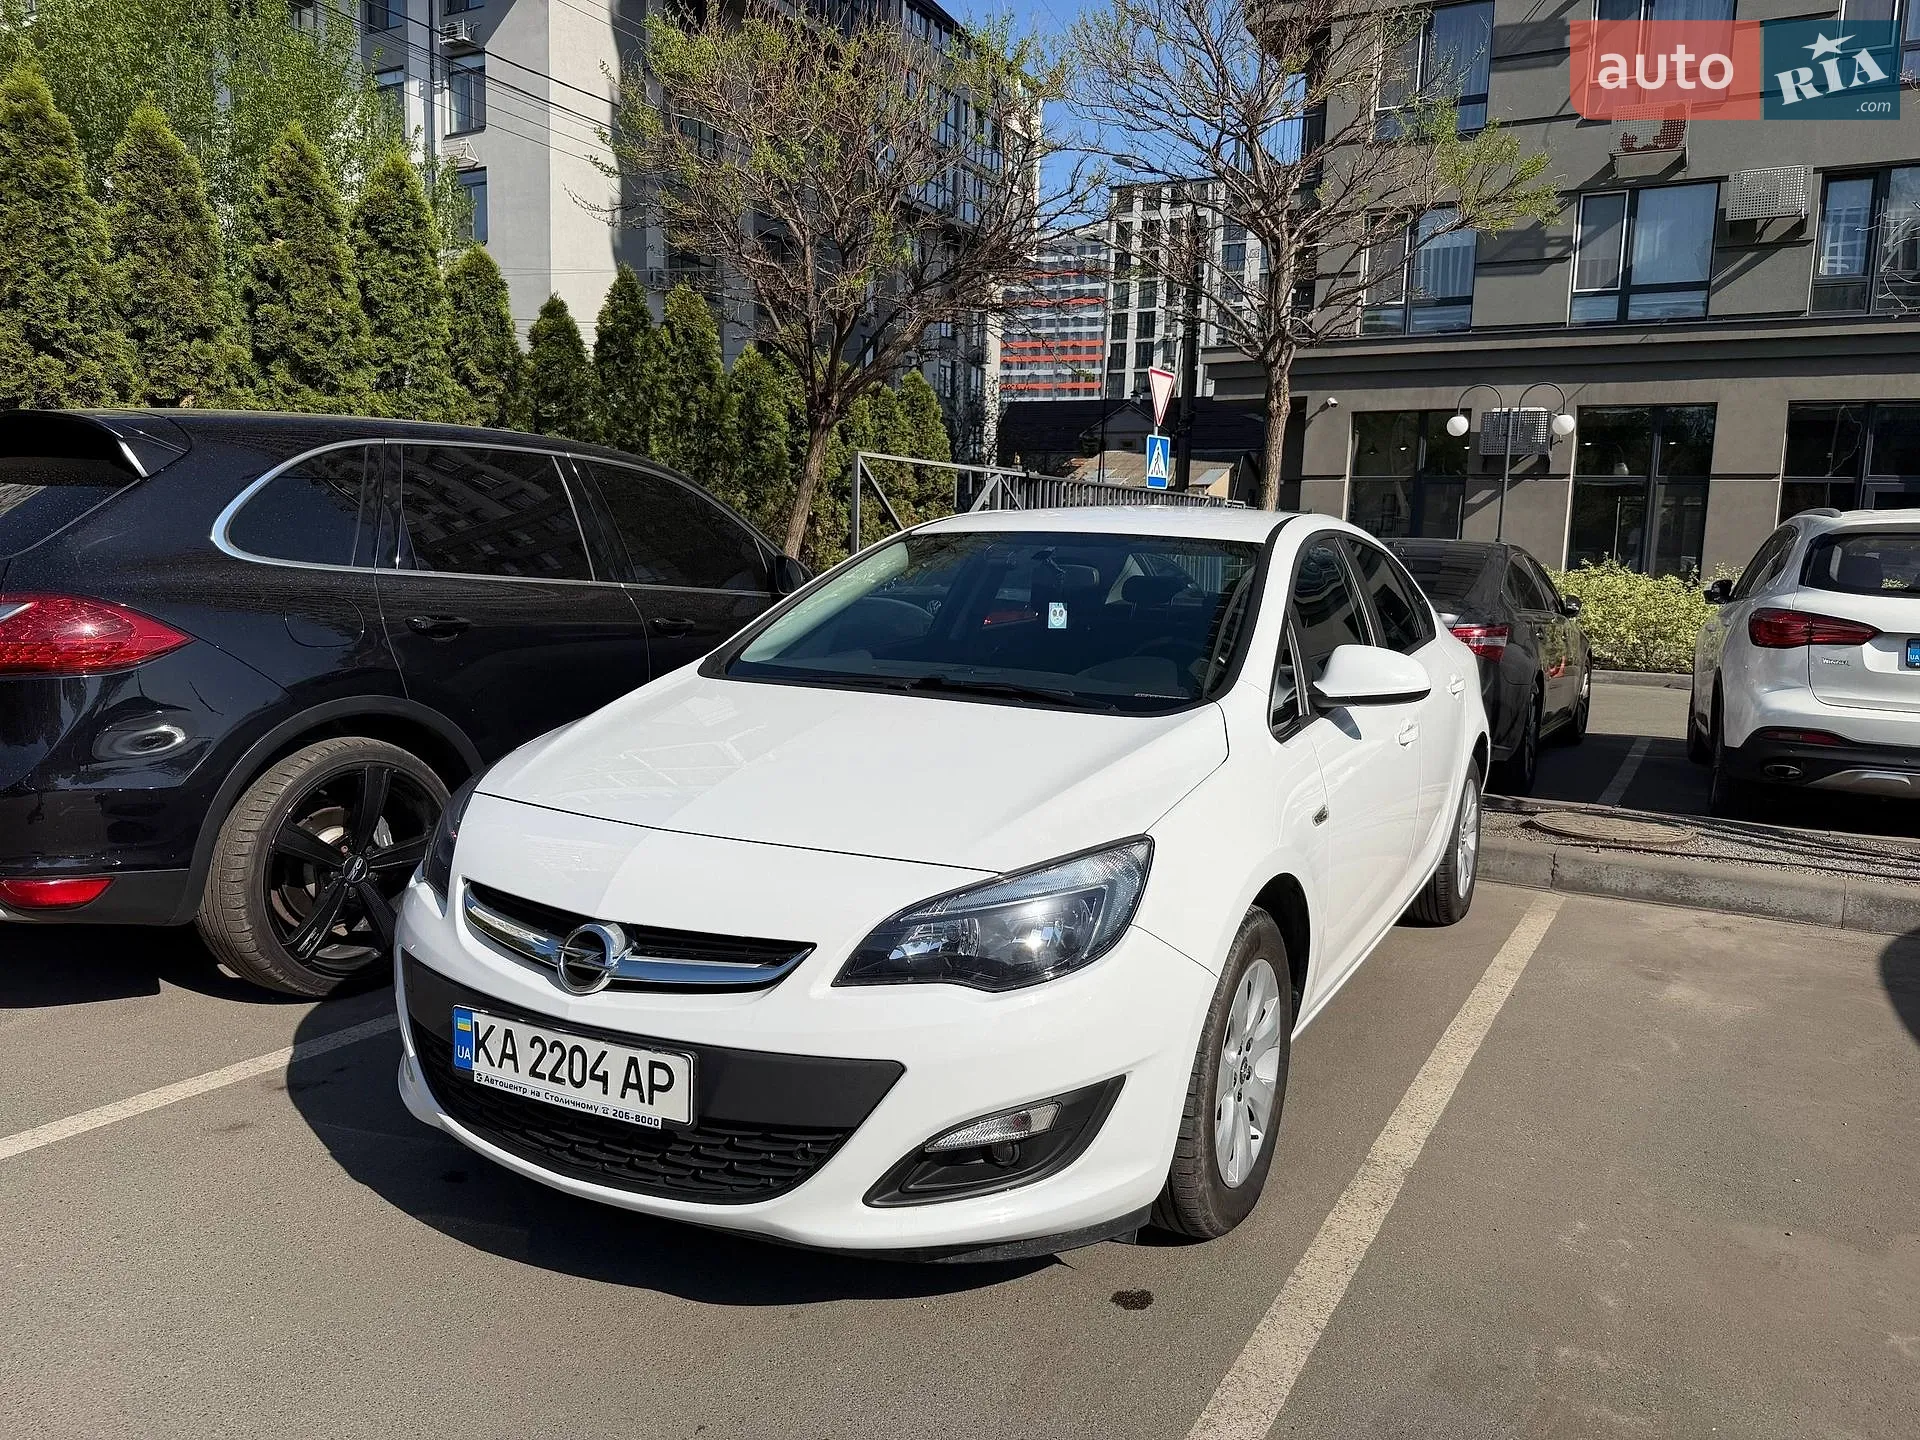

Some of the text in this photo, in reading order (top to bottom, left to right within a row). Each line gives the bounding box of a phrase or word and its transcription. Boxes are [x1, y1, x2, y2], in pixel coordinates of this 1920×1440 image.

[457, 1045, 471, 1060] UA
[474, 1020, 675, 1106] KA 2204 AP
[484, 1075, 660, 1127] Автоцентр на Столичному 206-8000
